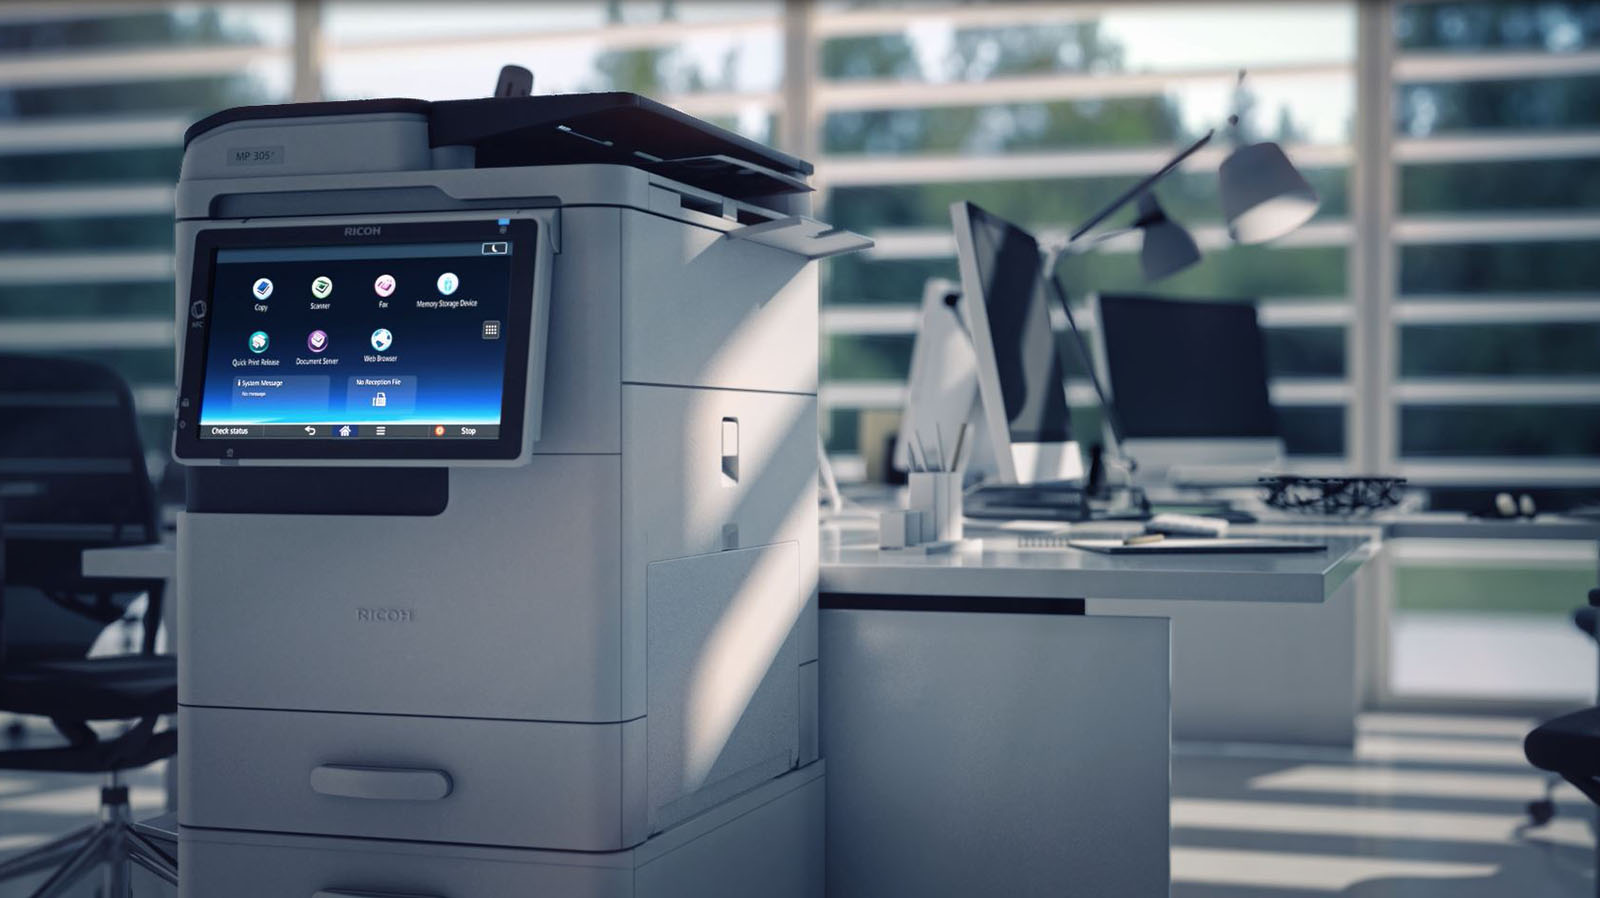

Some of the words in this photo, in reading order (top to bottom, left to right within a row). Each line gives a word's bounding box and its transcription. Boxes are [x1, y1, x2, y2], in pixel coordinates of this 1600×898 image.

[236, 151, 250, 161] MP
[344, 226, 382, 237] RICOH
[254, 303, 268, 312] Copy
[310, 302, 331, 310] Scanner
[416, 300, 438, 309] Memory
[439, 300, 459, 309] Storage
[460, 299, 478, 307] Device
[296, 357, 321, 366] Document
[322, 357, 339, 365] Server
[377, 354, 398, 362] Browser
[232, 358, 247, 368] Quick
[247, 358, 260, 366] Print
[260, 358, 280, 366] Release
[242, 380, 260, 388] System
[260, 379, 283, 388] Message
[365, 378, 391, 386] Reception
[391, 378, 402, 386] File
[211, 426, 229, 435] Check
[229, 426, 249, 435] status
[460, 426, 476, 436] Stop
[355, 607, 415, 621] RICOH
